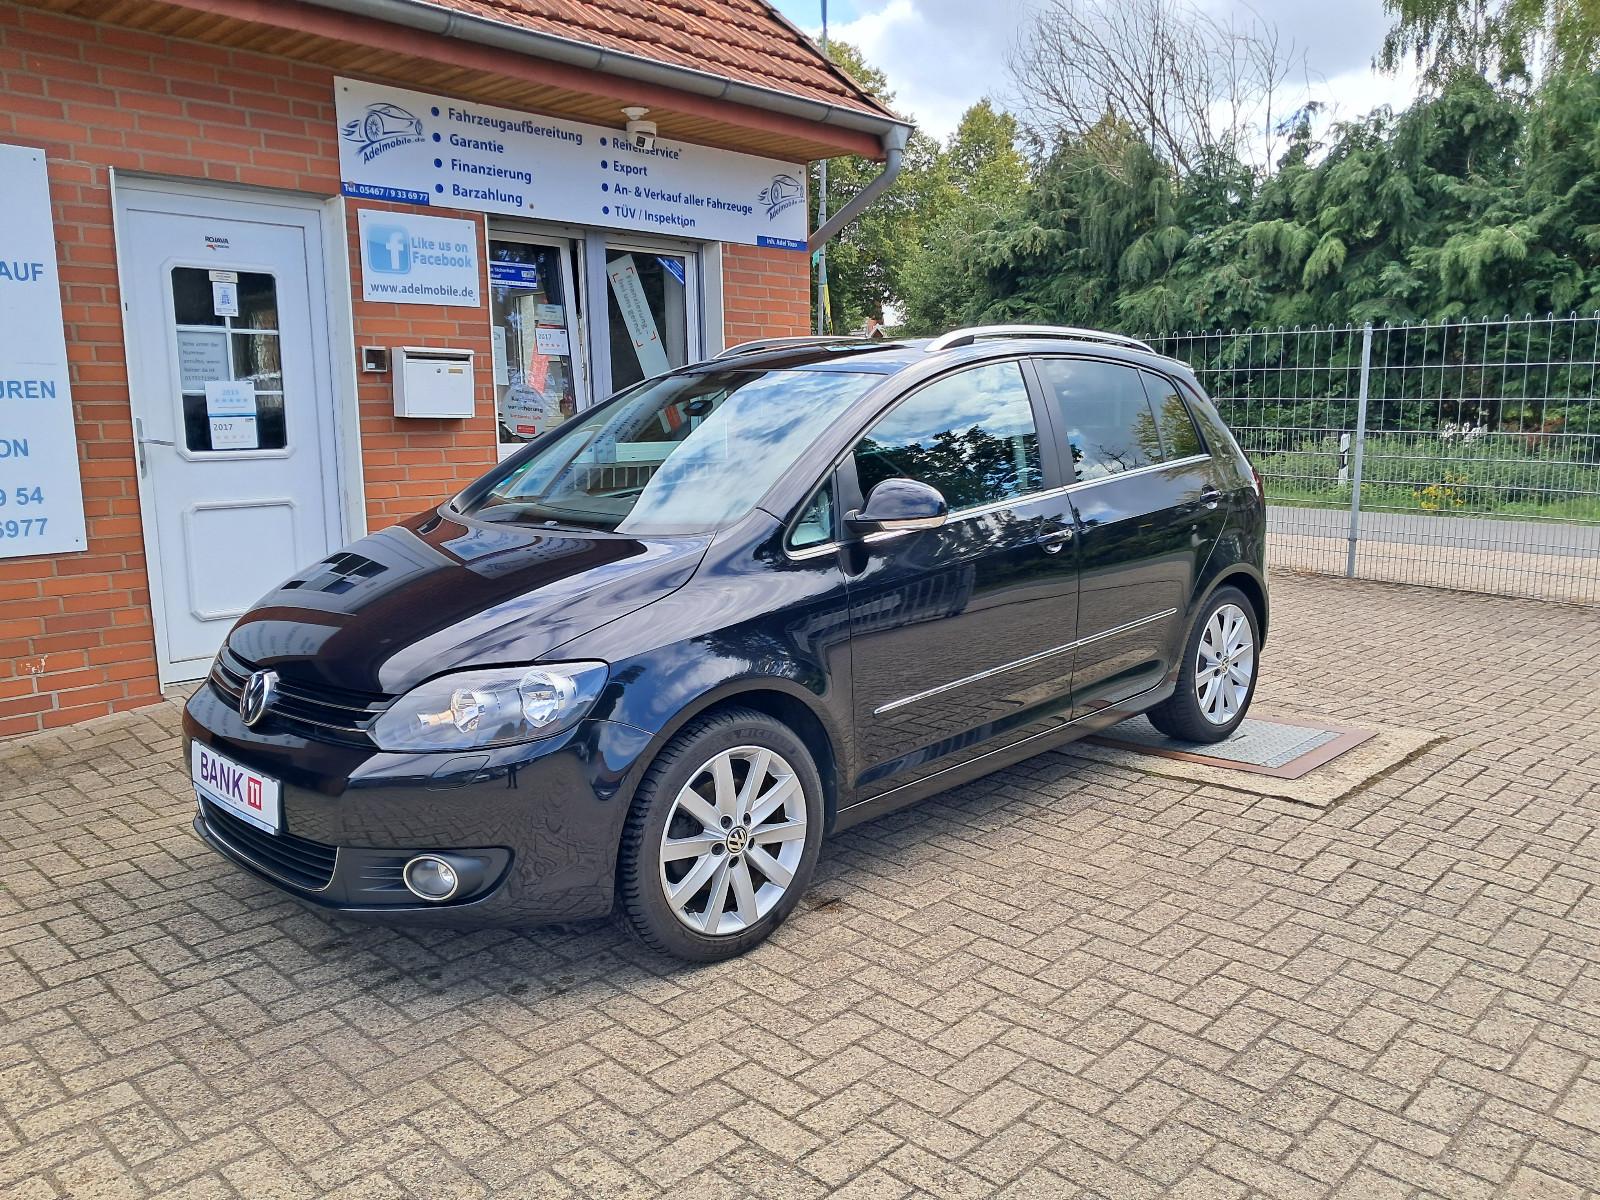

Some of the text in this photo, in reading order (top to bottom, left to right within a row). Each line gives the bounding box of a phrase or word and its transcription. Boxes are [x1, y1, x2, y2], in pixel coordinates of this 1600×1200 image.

[448, 107, 583, 146] Fahrzeugaufbereitung
[363, 137, 426, 165] Adelmobile.de
[449, 133, 504, 153] Garantie
[451, 158, 532, 185] Finanzierung
[613, 160, 648, 176] Export
[343, 183, 358, 193] Tel.
[359, 185, 384, 196] 05467
[390, 189, 396, 198] 9
[397, 190, 407, 199] 33
[407, 191, 418, 201] 69
[419, 193, 428, 201] 77
[452, 183, 523, 208] Barzahlung
[614, 183, 753, 216] An- & Verkauf aller Fahrzeuge
[614, 204, 636, 219] TÜV
[644, 209, 696, 227] Inspektion
[410, 237, 469, 253] Like us on
[412, 251, 472, 268] Facebook
[370, 283, 474, 298] www.adelmobile.de
[0, 380, 56, 399] REN
[213, 423, 233, 431] 2017
[200, 751, 244, 803] BANK
